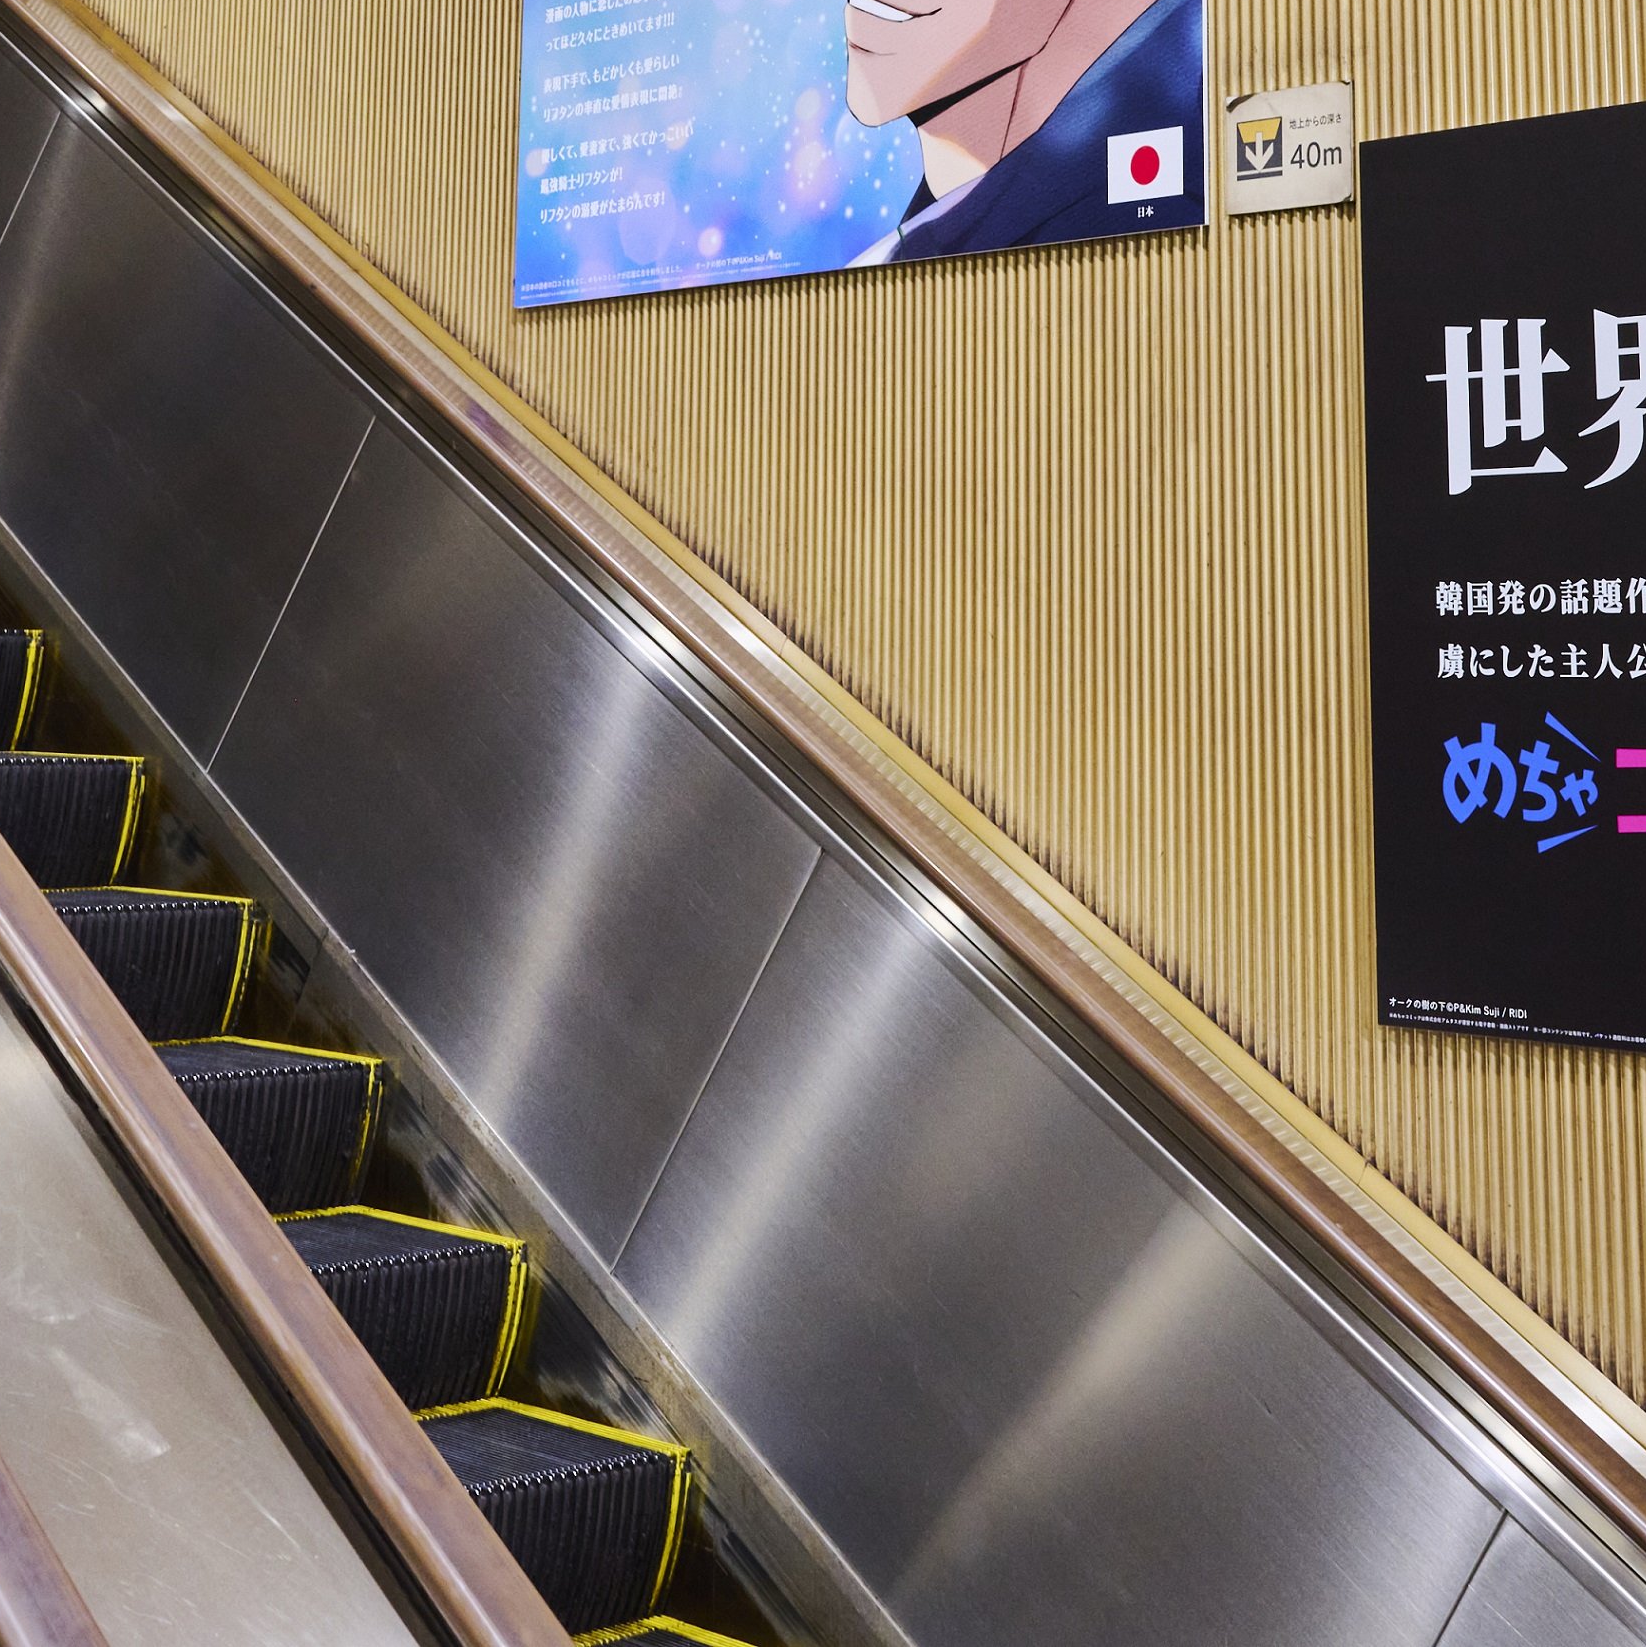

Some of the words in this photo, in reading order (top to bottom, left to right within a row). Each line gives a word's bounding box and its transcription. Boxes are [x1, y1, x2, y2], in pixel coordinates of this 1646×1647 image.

[1289, 113, 1342, 129] 地上からの深さ
[1290, 142, 1342, 169] 40m
[1137, 205, 1154, 218] 日本
[1483, 1005, 1500, 1018] Suji
[1509, 1008, 1528, 1020] RIDI
